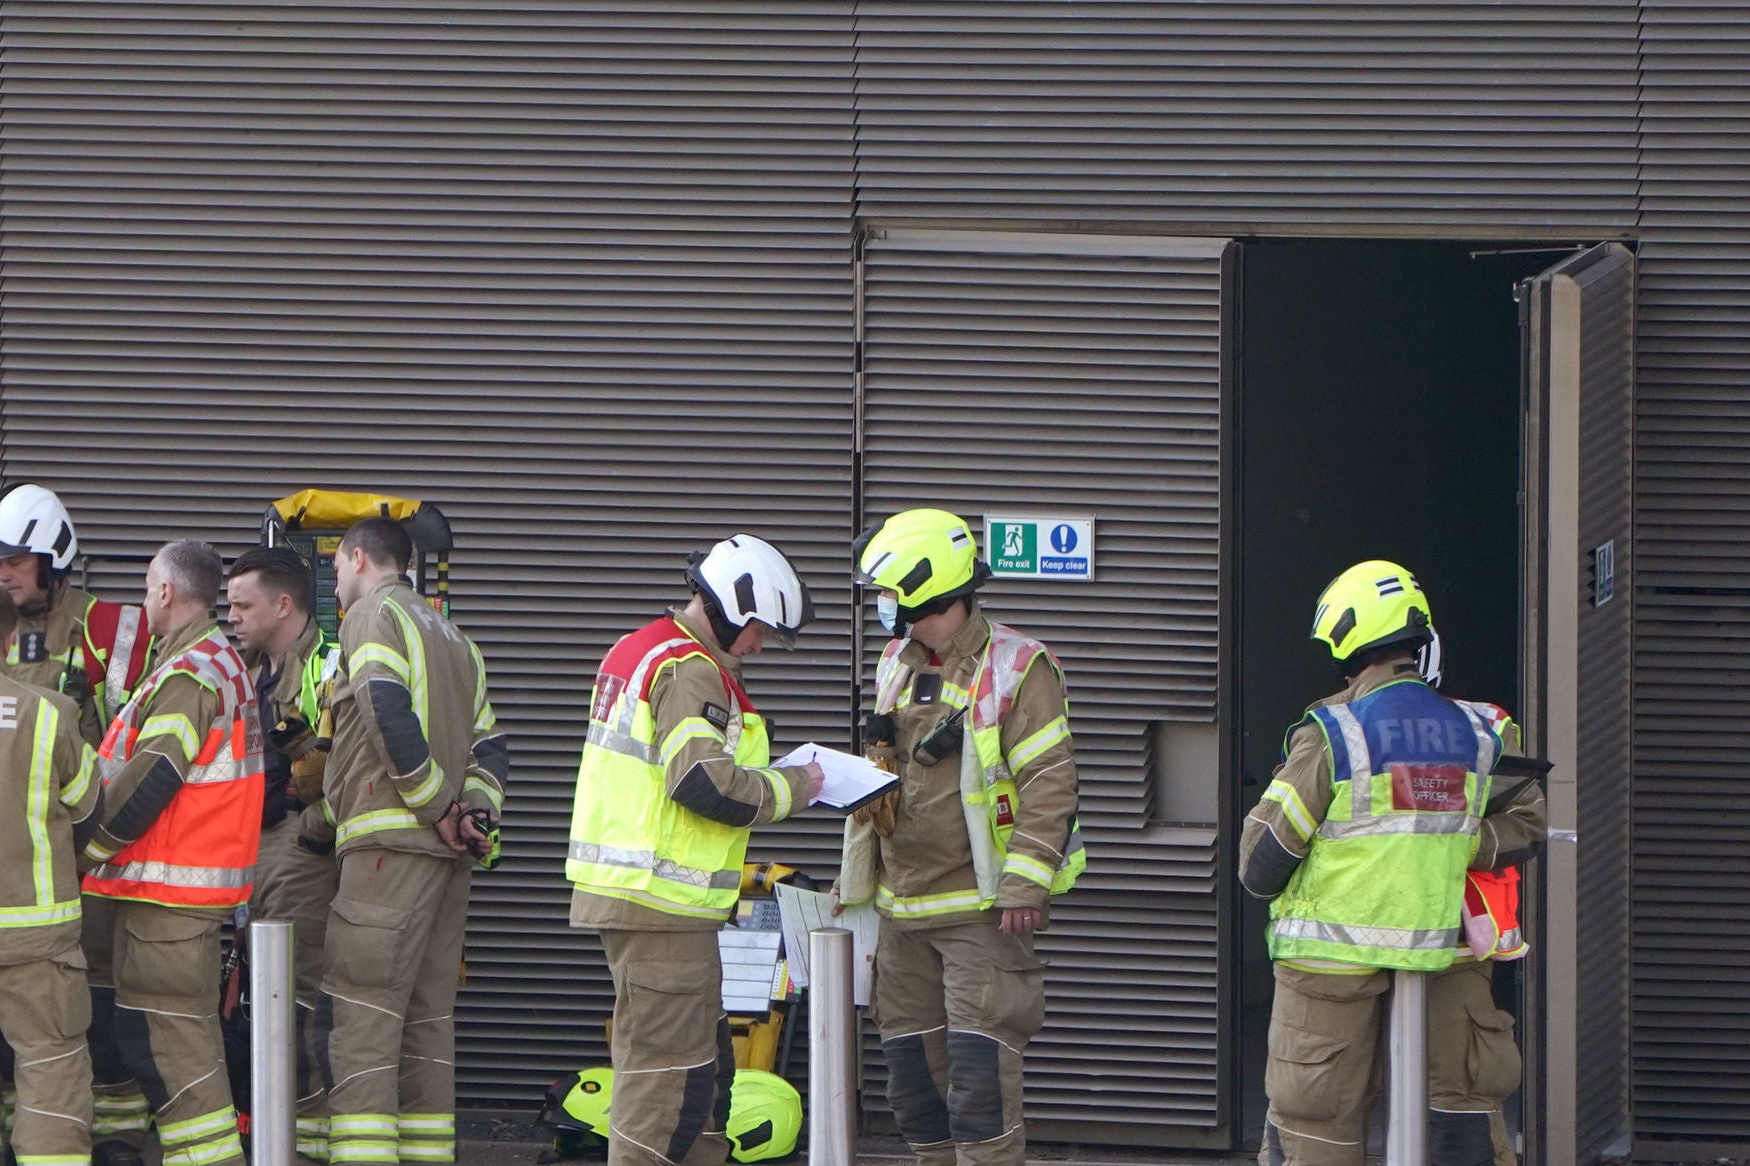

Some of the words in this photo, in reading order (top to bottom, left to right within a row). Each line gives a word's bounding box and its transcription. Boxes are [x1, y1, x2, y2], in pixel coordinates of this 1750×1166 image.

[998, 559, 1014, 569] Fire
[1015, 559, 1030, 569] exit
[1042, 560, 1064, 571] Keep
[1065, 561, 1086, 571] clear
[1376, 718, 1466, 754] FIRE
[1412, 778, 1449, 789] SAFETY
[1412, 790, 1450, 802] OFFICER
